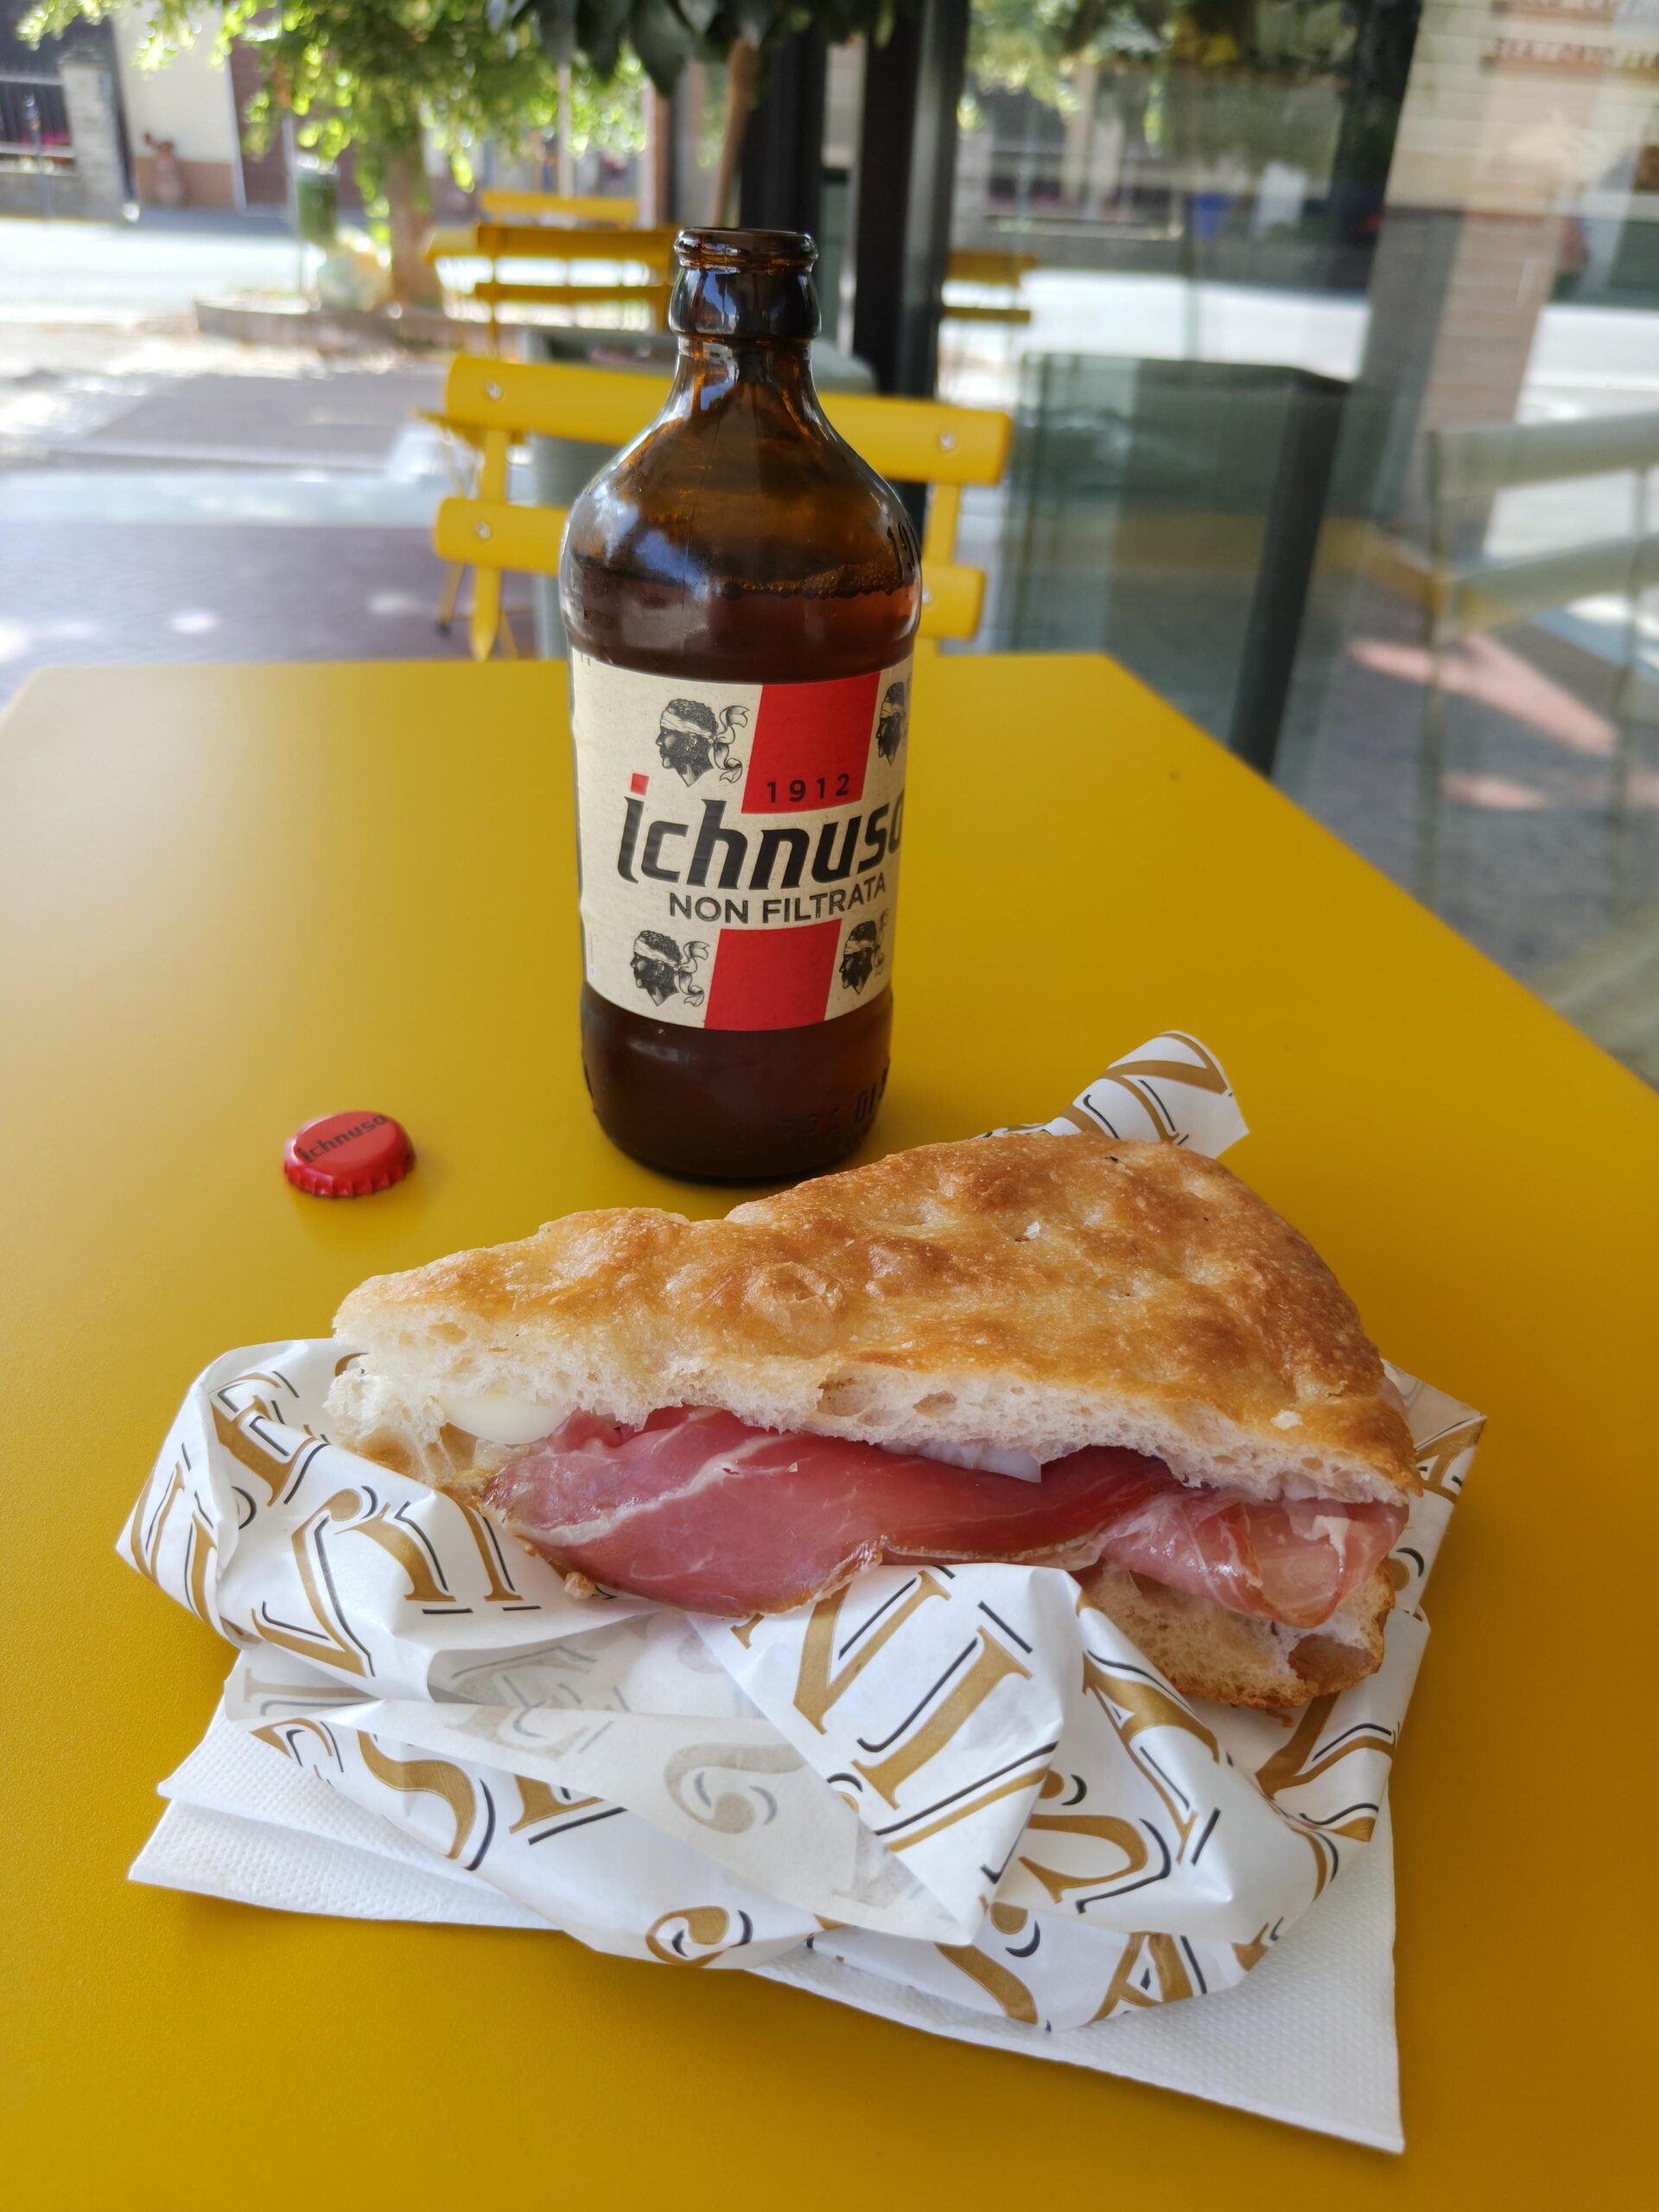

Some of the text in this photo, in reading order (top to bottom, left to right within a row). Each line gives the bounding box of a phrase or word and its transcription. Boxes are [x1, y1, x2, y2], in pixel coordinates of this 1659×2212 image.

[766, 773, 850, 803] 1912
[670, 872, 886, 924] NON FILTRATA
